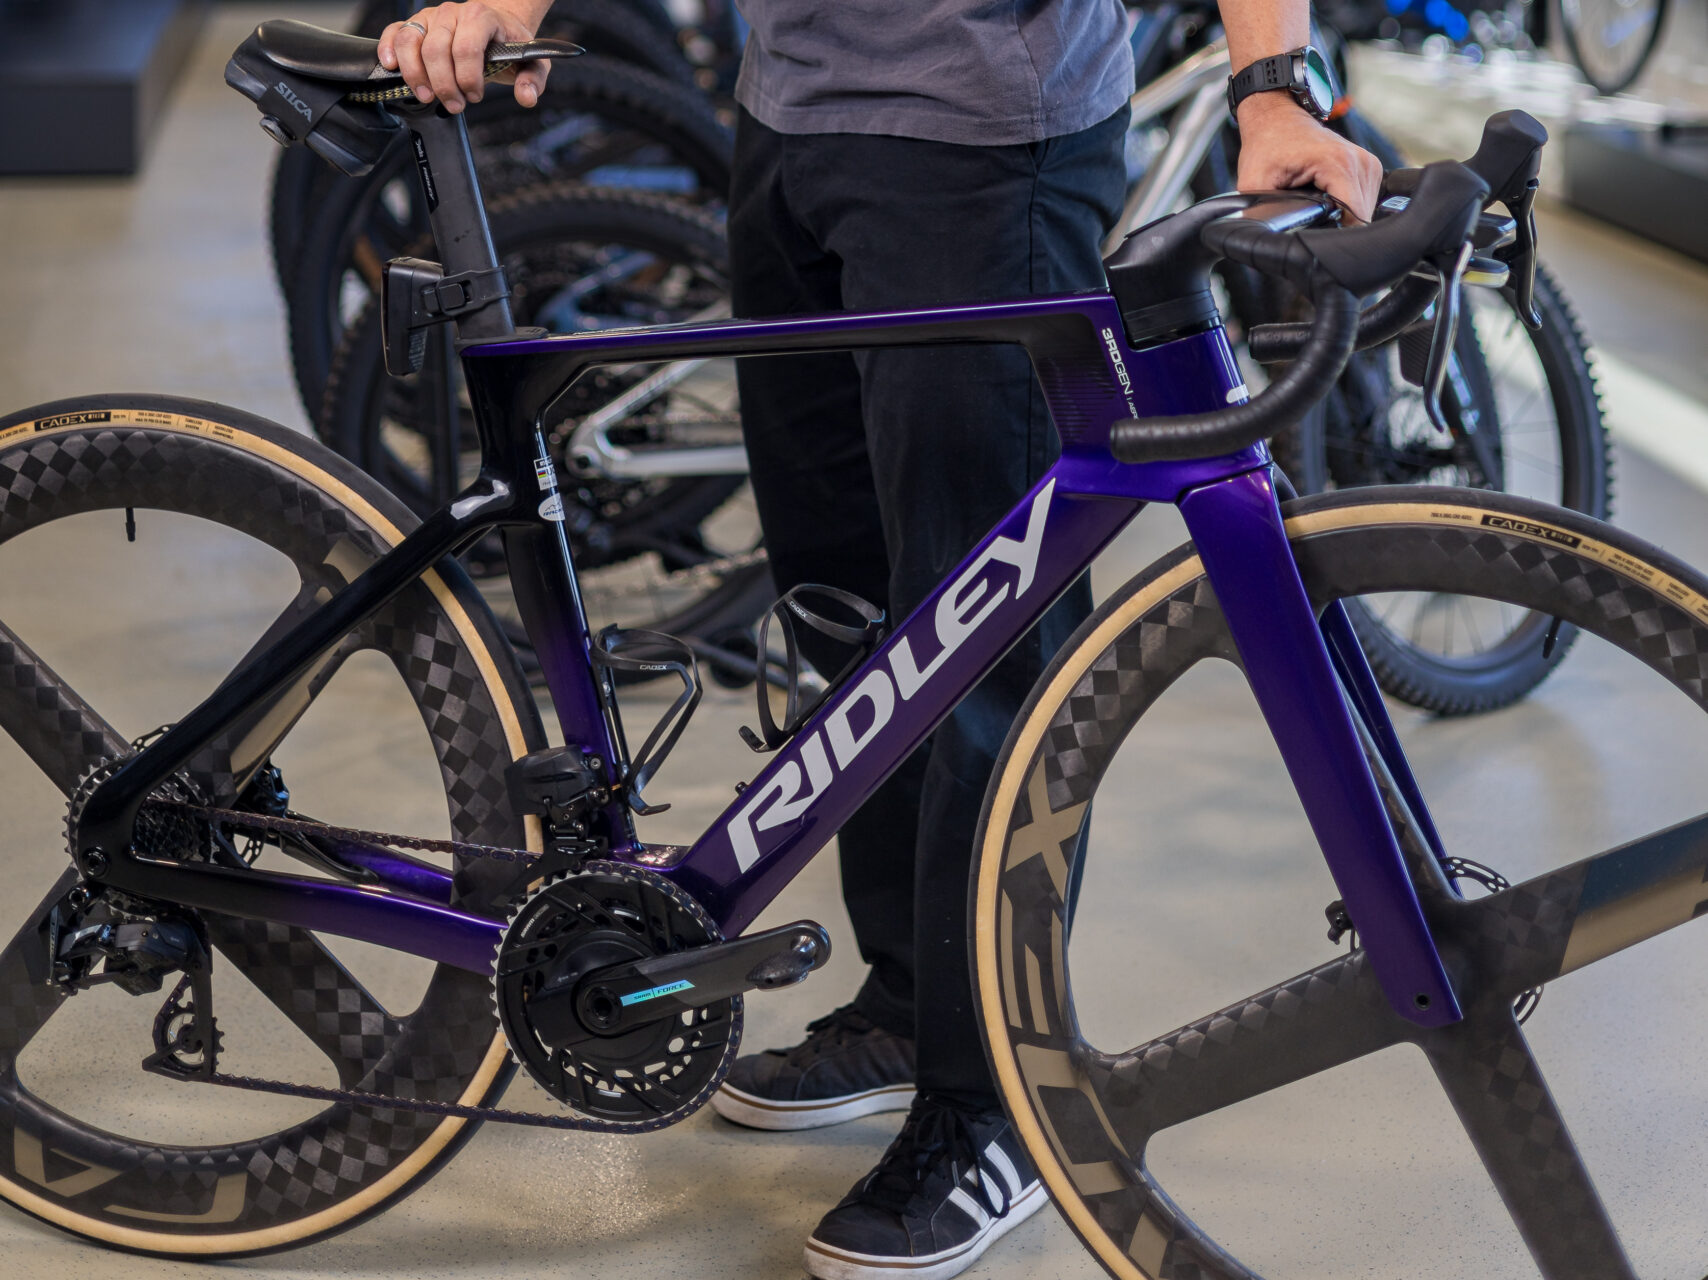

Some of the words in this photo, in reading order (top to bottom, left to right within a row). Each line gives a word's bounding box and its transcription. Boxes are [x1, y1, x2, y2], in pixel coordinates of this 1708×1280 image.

[273, 81, 312, 123] SILCA
[1101, 327, 1134, 395] 3RDGEN
[40, 414, 87, 430] CADEX
[1488, 517, 1549, 538] CADEX
[727, 477, 1056, 874] RIDLEY
[657, 982, 685, 995] FORCE
